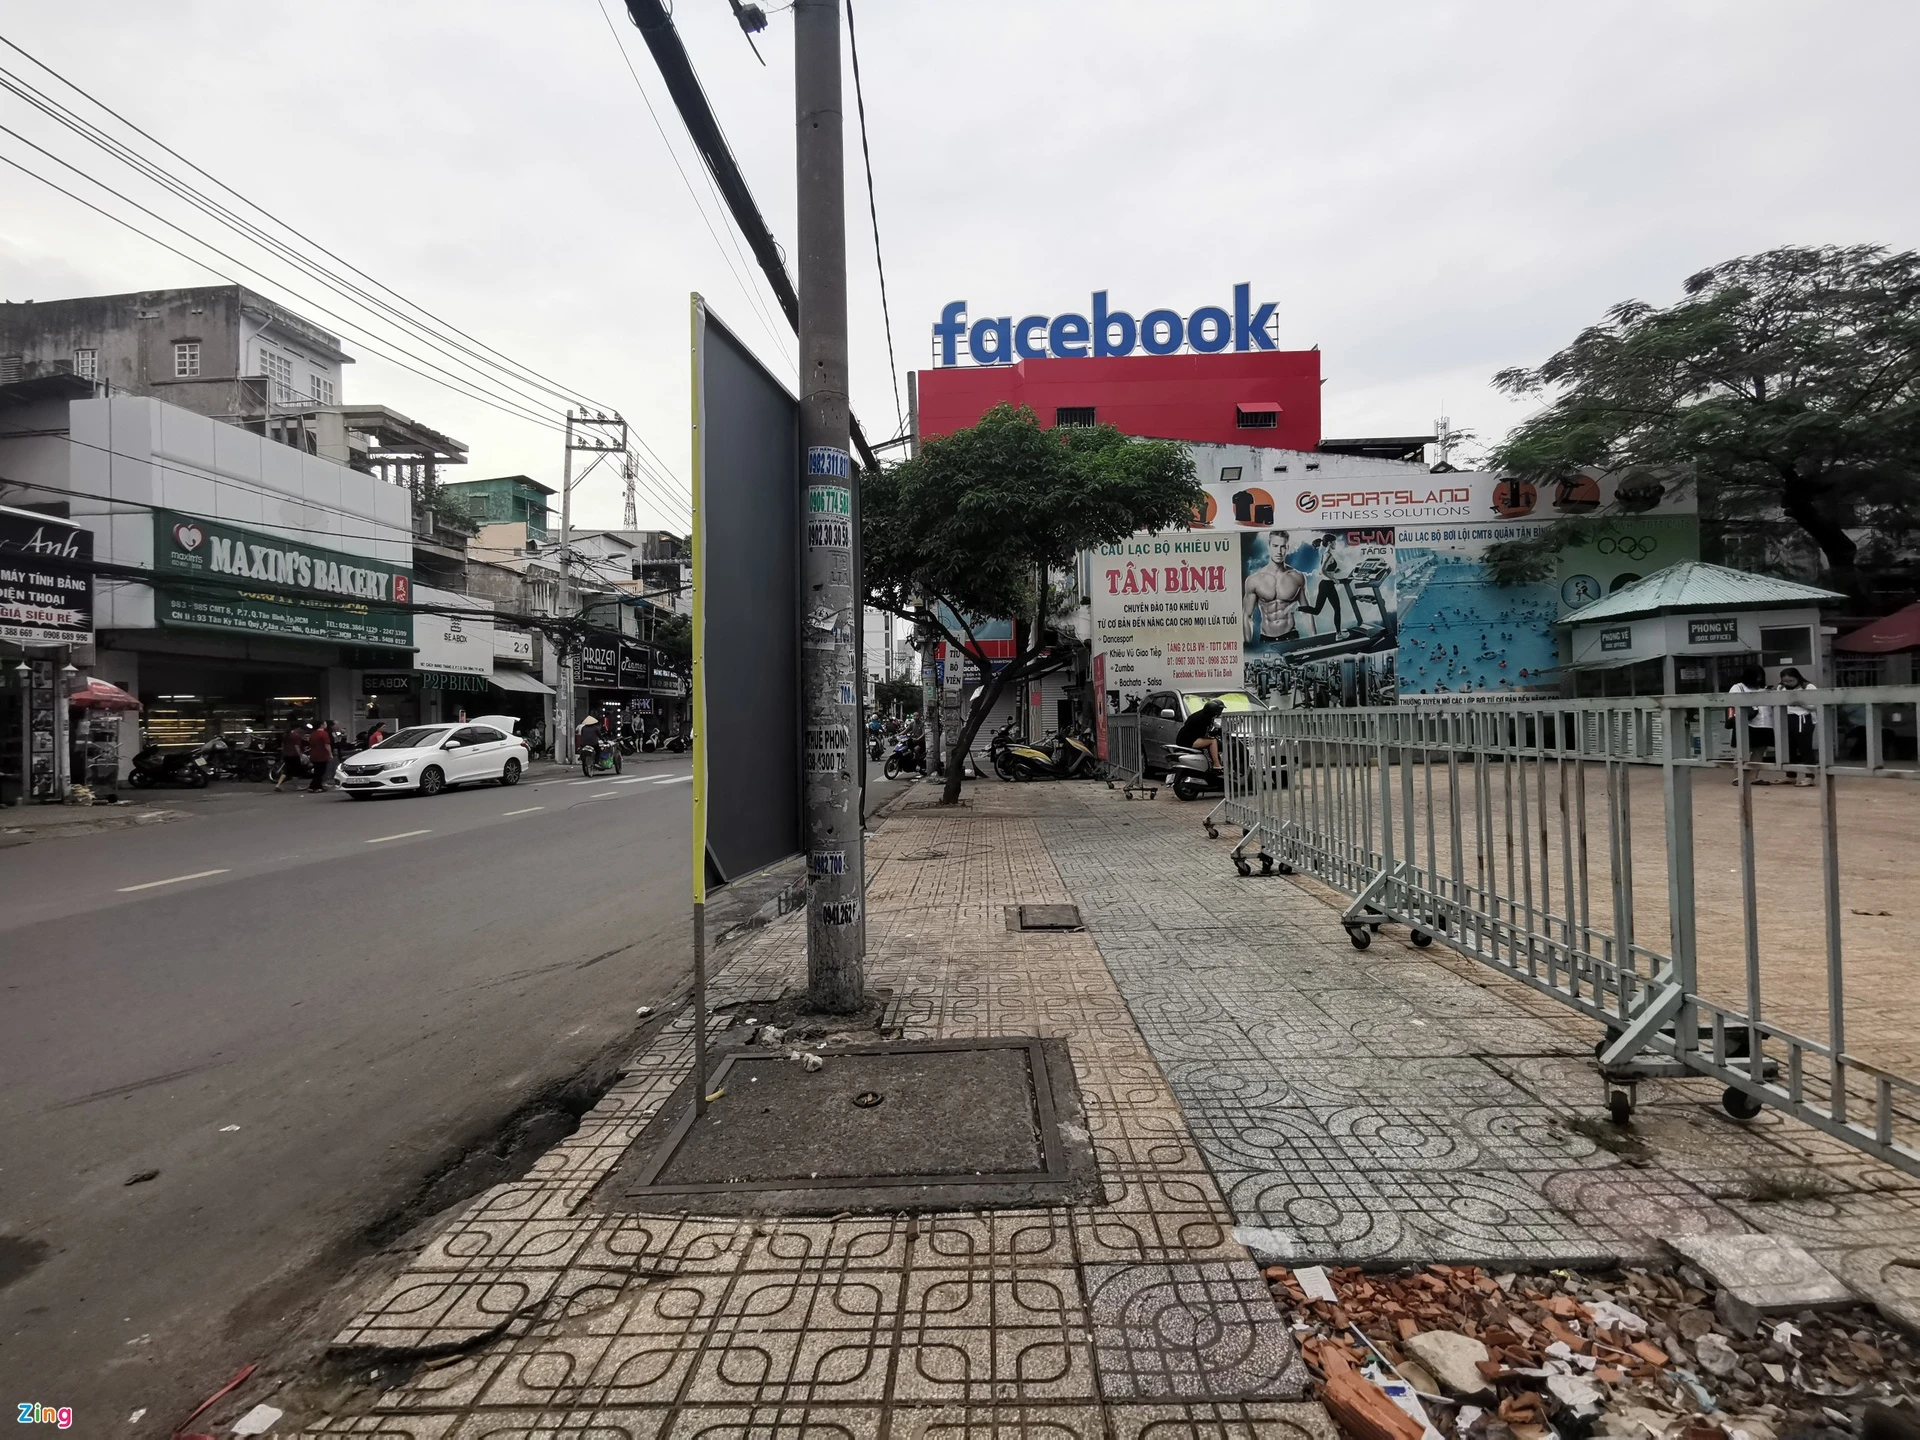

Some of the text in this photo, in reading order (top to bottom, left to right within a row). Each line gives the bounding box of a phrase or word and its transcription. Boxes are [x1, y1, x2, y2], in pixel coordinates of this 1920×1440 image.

[932, 281, 1281, 367] facebook
[1321, 487, 1470, 508] SPORTSLAND
[1321, 505, 1471, 520] FITNESS SOLUTIONS
[1346, 530, 1394, 546] GYM
[1398, 529, 1413, 543] CÂU
[1415, 531, 1429, 544] LẠC
[1431, 528, 1441, 543] BỘ
[1458, 527, 1470, 541] LỘI
[1472, 528, 1493, 540] CMT8
[1494, 526, 1515, 542] QUẬN
[1516, 525, 1532, 539] TÂN
[21, 526, 80, 559] Anh
[1128, 543, 1150, 557] LẠC
[1154, 540, 1170, 556] BỘ
[1175, 538, 1211, 554] KHIÊU
[1214, 537, 1230, 552] VŨ
[210, 536, 312, 588] MAXIM'S
[313, 559, 389, 601] BAKERY
[1, 568, 86, 592] MÁY TÍNH BẢNG
[1105, 559, 1227, 595] TÂN BÌNH
[28, 591, 65, 606] THOẠI
[1123, 599, 1209, 613] CHUYÊN ĐÀO TẠO KHIÊU VŨ
[0, 606, 73, 623] GIÁ SIÊU RẺ
[1107, 617, 1117, 628] CƠ
[1117, 616, 1131, 628] BẢN
[1132, 616, 1146, 628] ĐẾN
[1147, 616, 1164, 627] NÂNG
[1165, 617, 1178, 627] CAO
[1179, 617, 1193, 626] CHO
[1194, 616, 1207, 628] MỌI
[1222, 612, 1237, 625] TUỔI
[1691, 620, 1735, 633] PHÒNG VÉ
[443, 632, 468, 644] SEABOX
[1102, 634, 1134, 645] Dancesport
[1109, 648, 1126, 658] Khiêu
[1136, 648, 1148, 657] Giao
[1182, 643, 1186, 652] 2
[1114, 664, 1134, 673] Zumba
[364, 678, 408, 688] SEABOX
[1119, 678, 1142, 687] Bachata
[1147, 677, 1162, 686] Salsa
